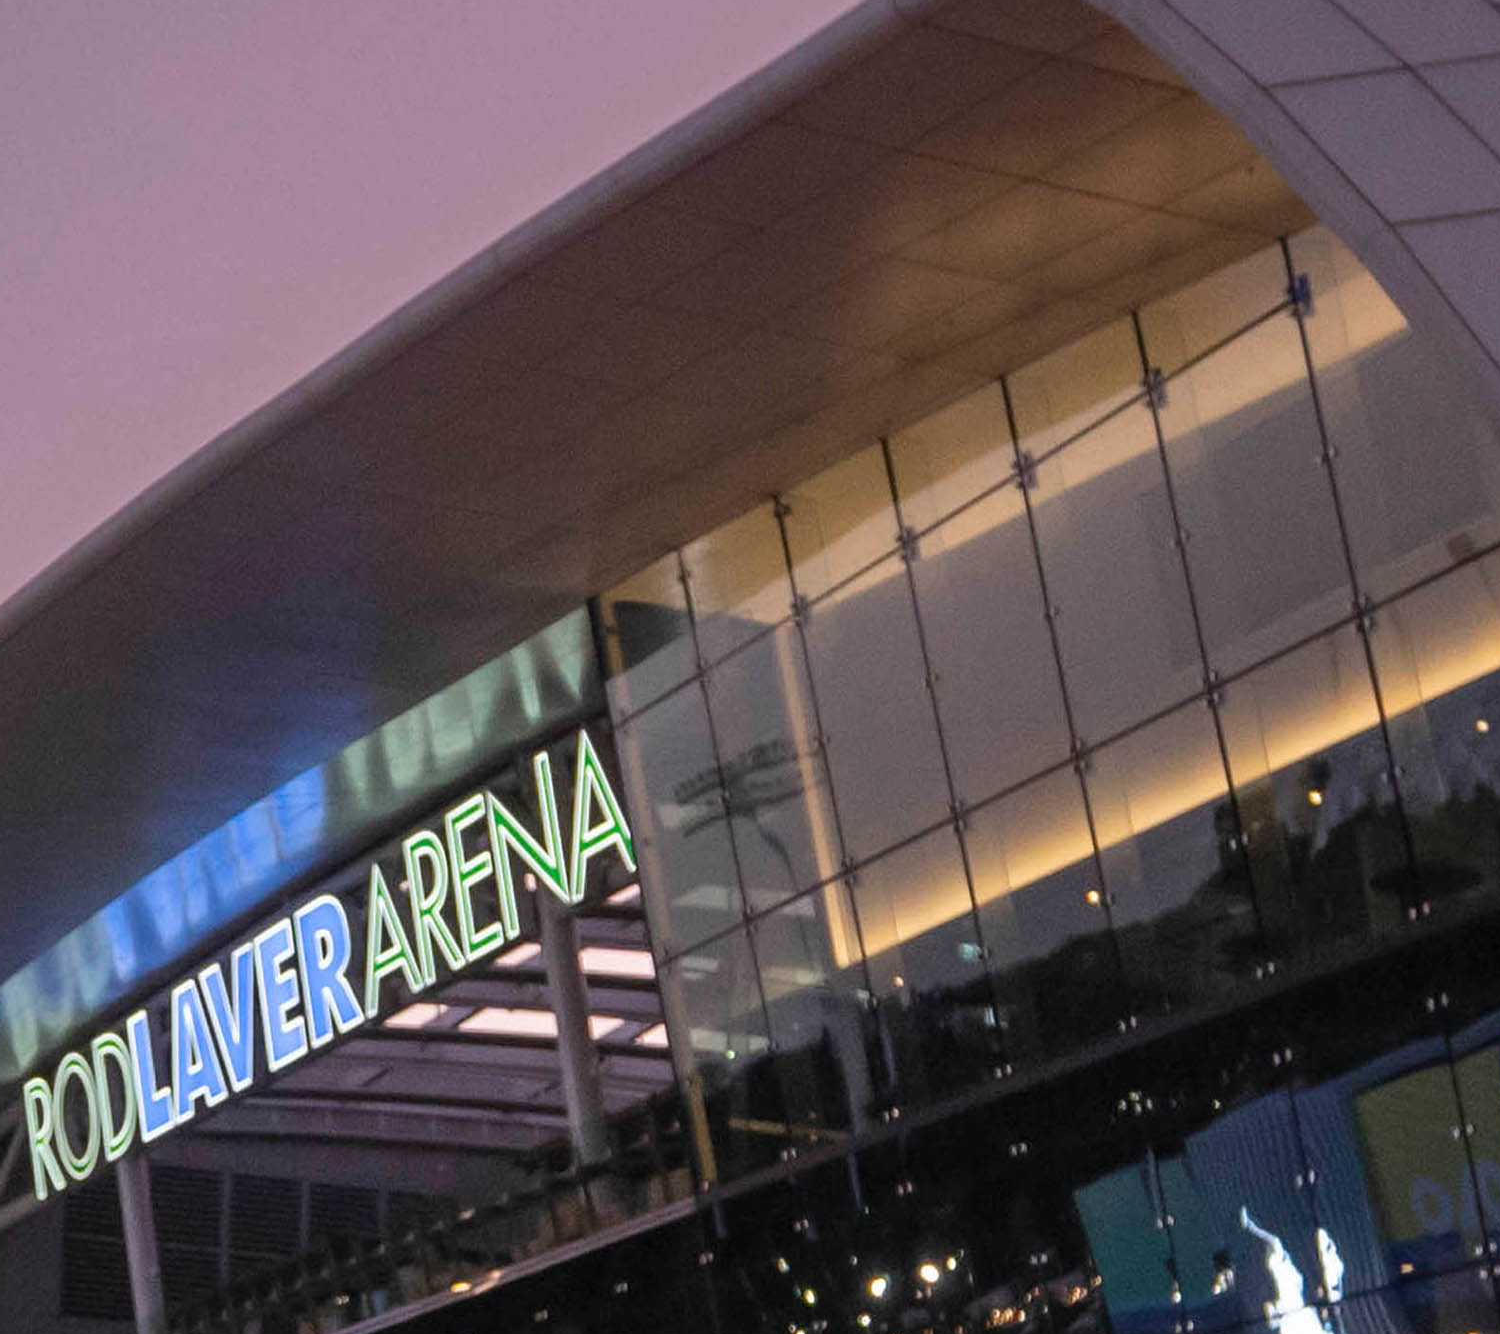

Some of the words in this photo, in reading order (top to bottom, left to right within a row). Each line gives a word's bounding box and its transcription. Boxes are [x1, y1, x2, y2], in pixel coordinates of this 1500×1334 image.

[23, 1031, 138, 1202] ROD
[125, 893, 368, 1144] LAVER
[364, 727, 638, 1020] ARENA
